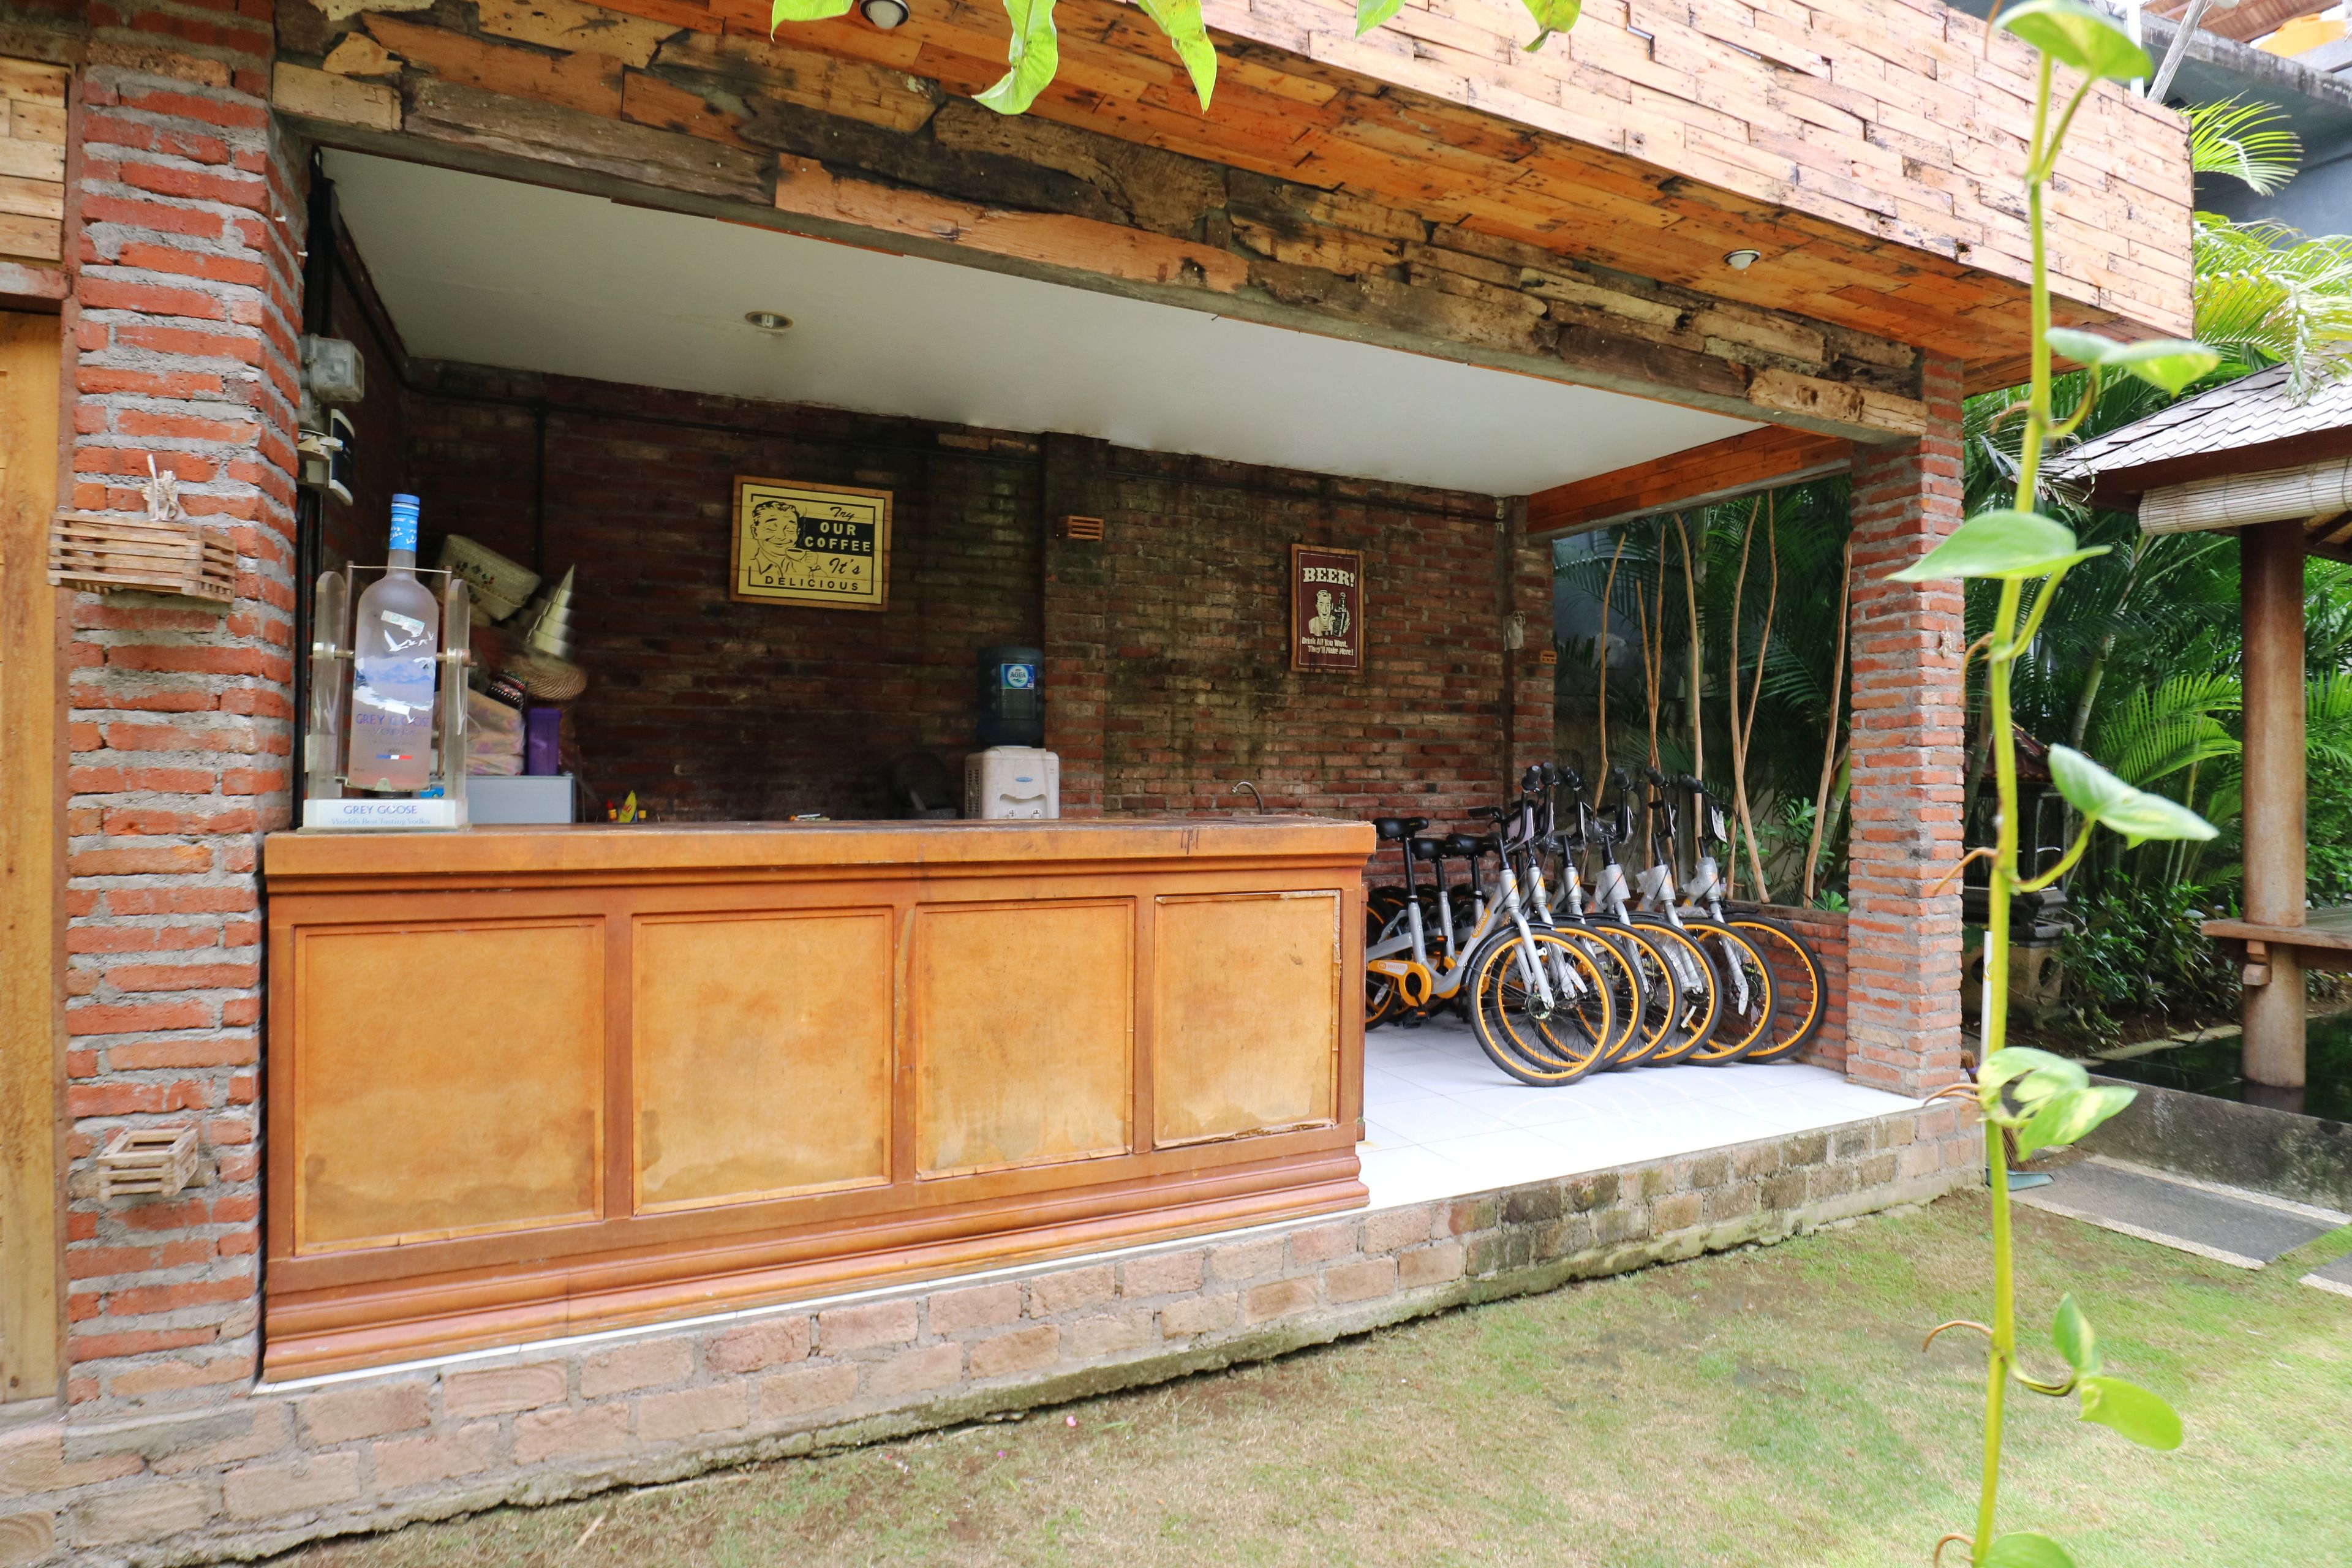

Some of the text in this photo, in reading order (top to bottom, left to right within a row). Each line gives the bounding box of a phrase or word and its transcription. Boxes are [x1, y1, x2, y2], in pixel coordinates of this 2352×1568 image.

[830, 507, 854, 521] Try
[820, 522, 856, 535] OUR
[804, 537, 871, 552] COFFEE
[829, 558, 861, 574] It's
[765, 576, 859, 590] DELICIOUS
[1303, 568, 1355, 587] BEER!
[1334, 639, 1348, 648] Want,
[356, 714, 385, 724] GREY
[344, 805, 418, 814] GREY GOOSE
